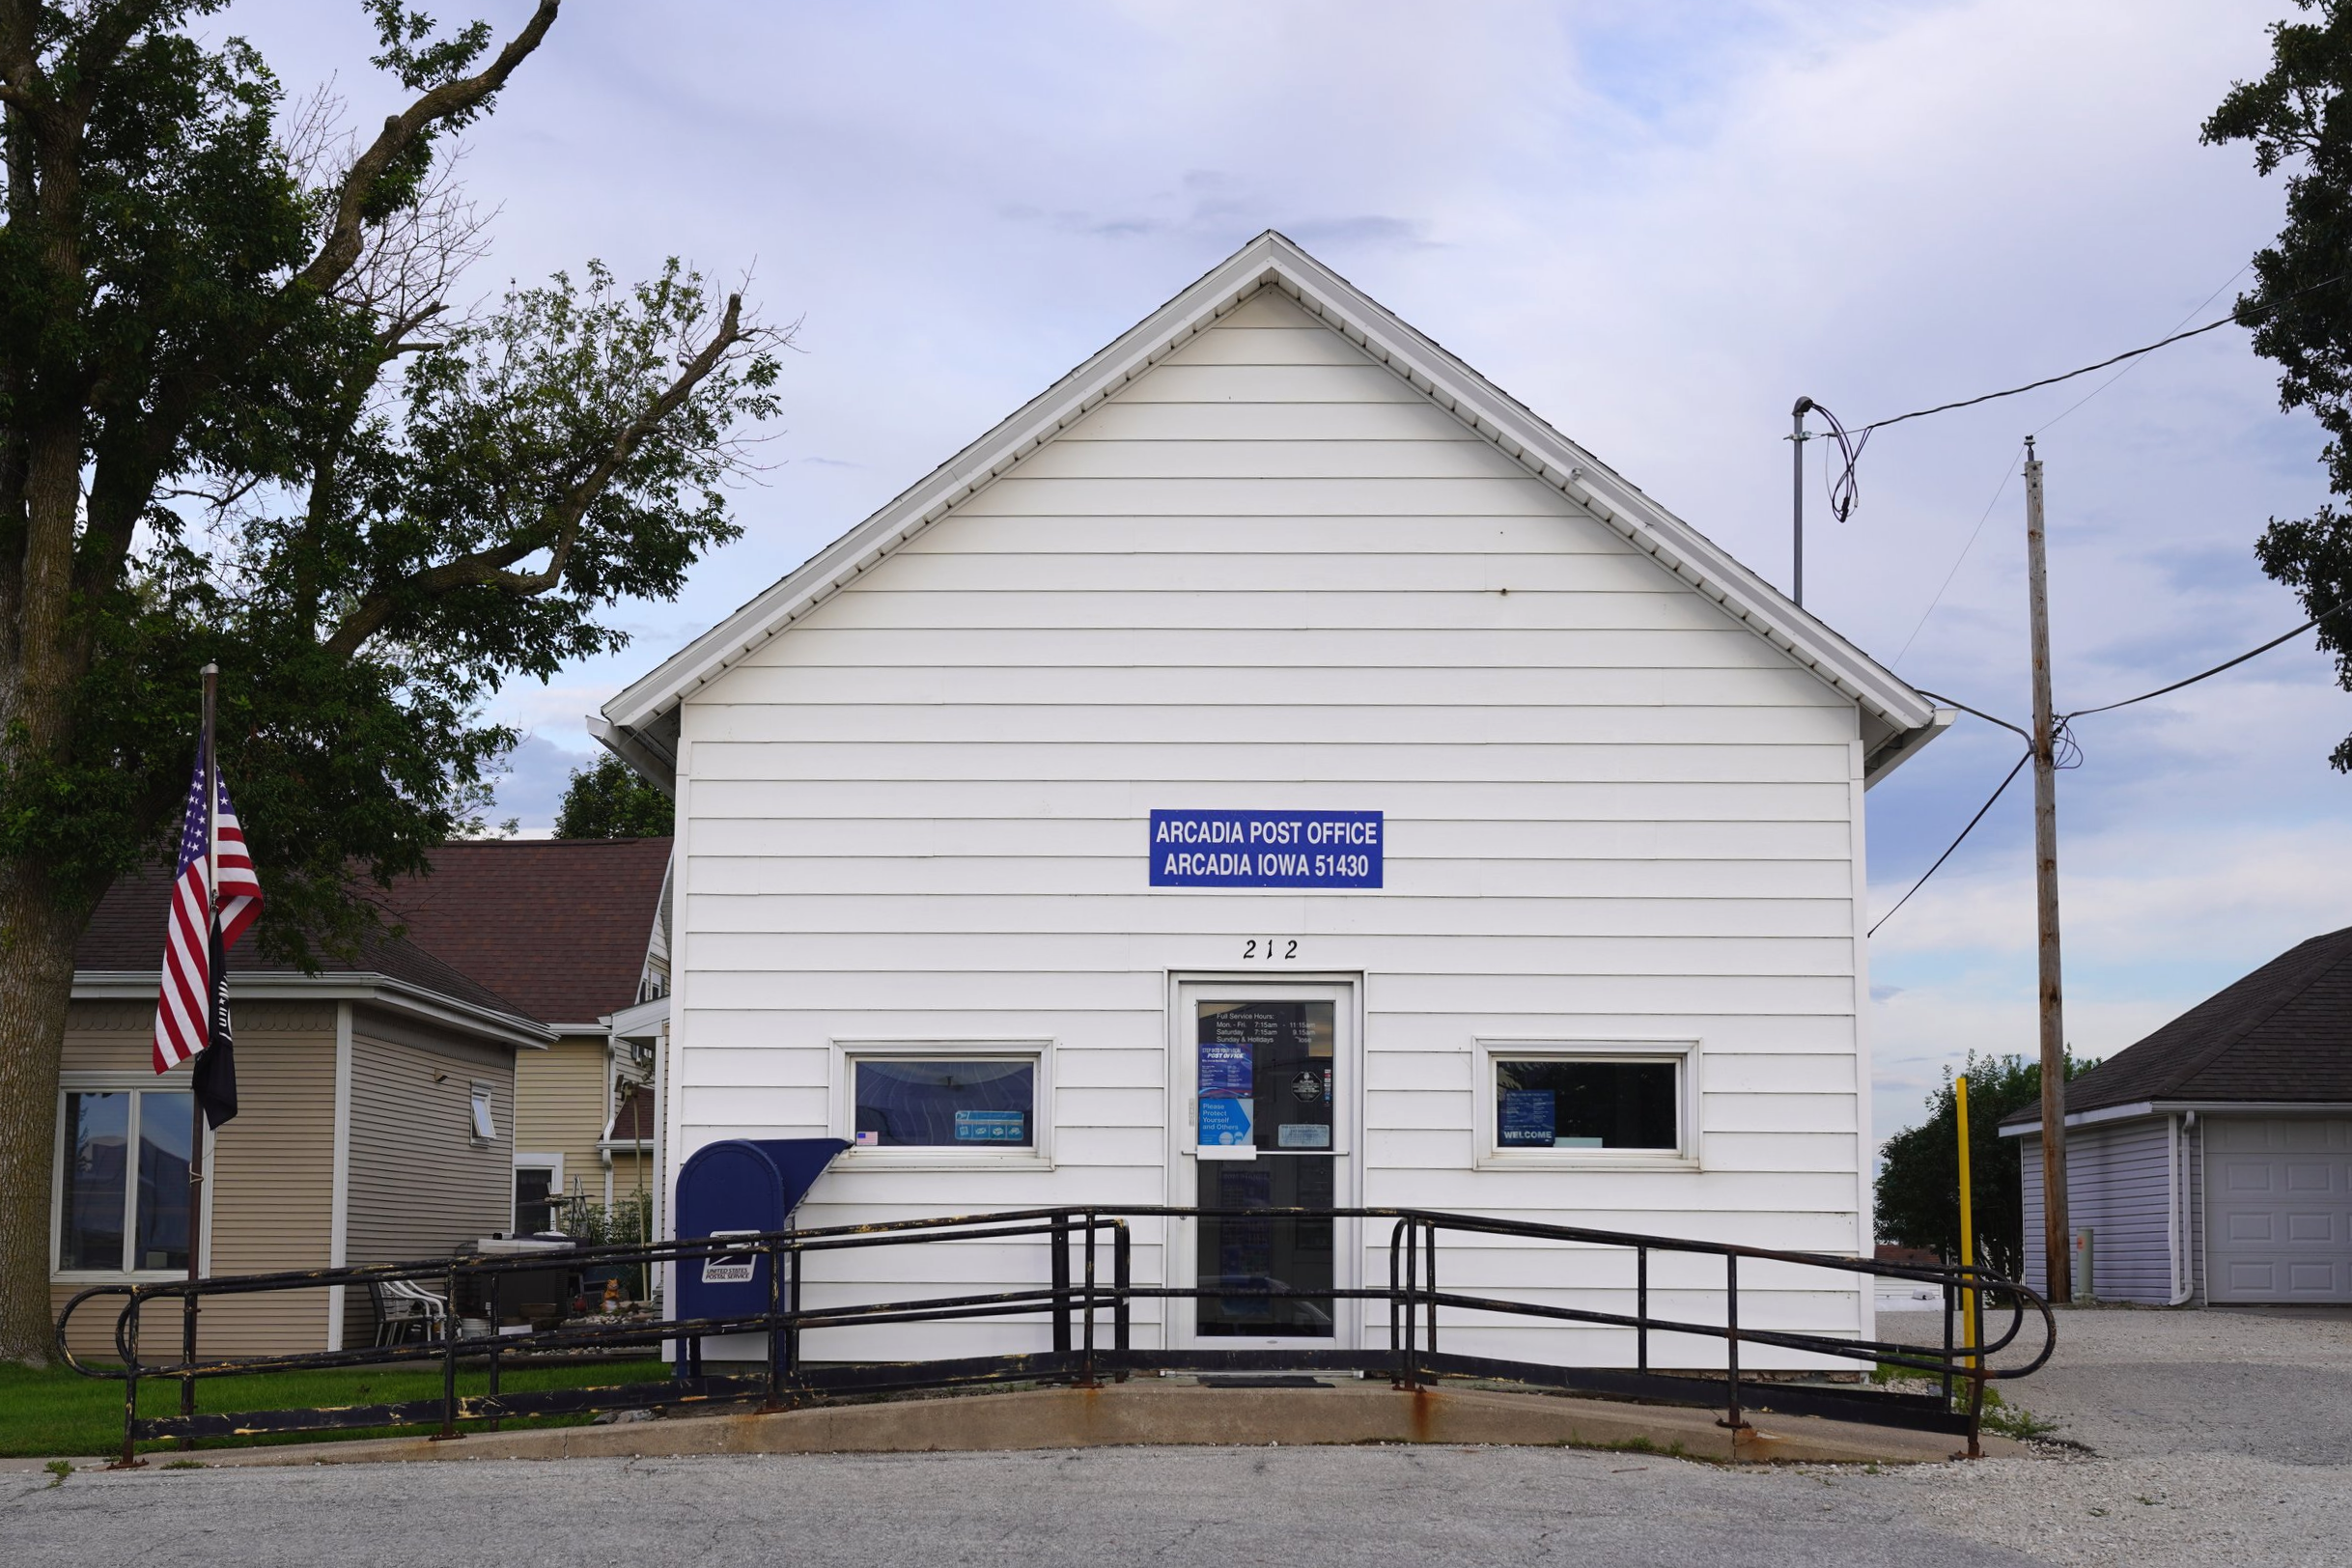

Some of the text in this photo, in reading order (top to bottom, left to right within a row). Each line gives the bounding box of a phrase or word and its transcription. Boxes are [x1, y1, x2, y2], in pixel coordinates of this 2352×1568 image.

[1156, 821, 1377, 845] ARCADIA POST OFFICE
[1163, 853, 1369, 877] ARCADIA IOWA 51430
[1243, 938, 1298, 960] 212
[1503, 1131, 1553, 1139] WELCOME
